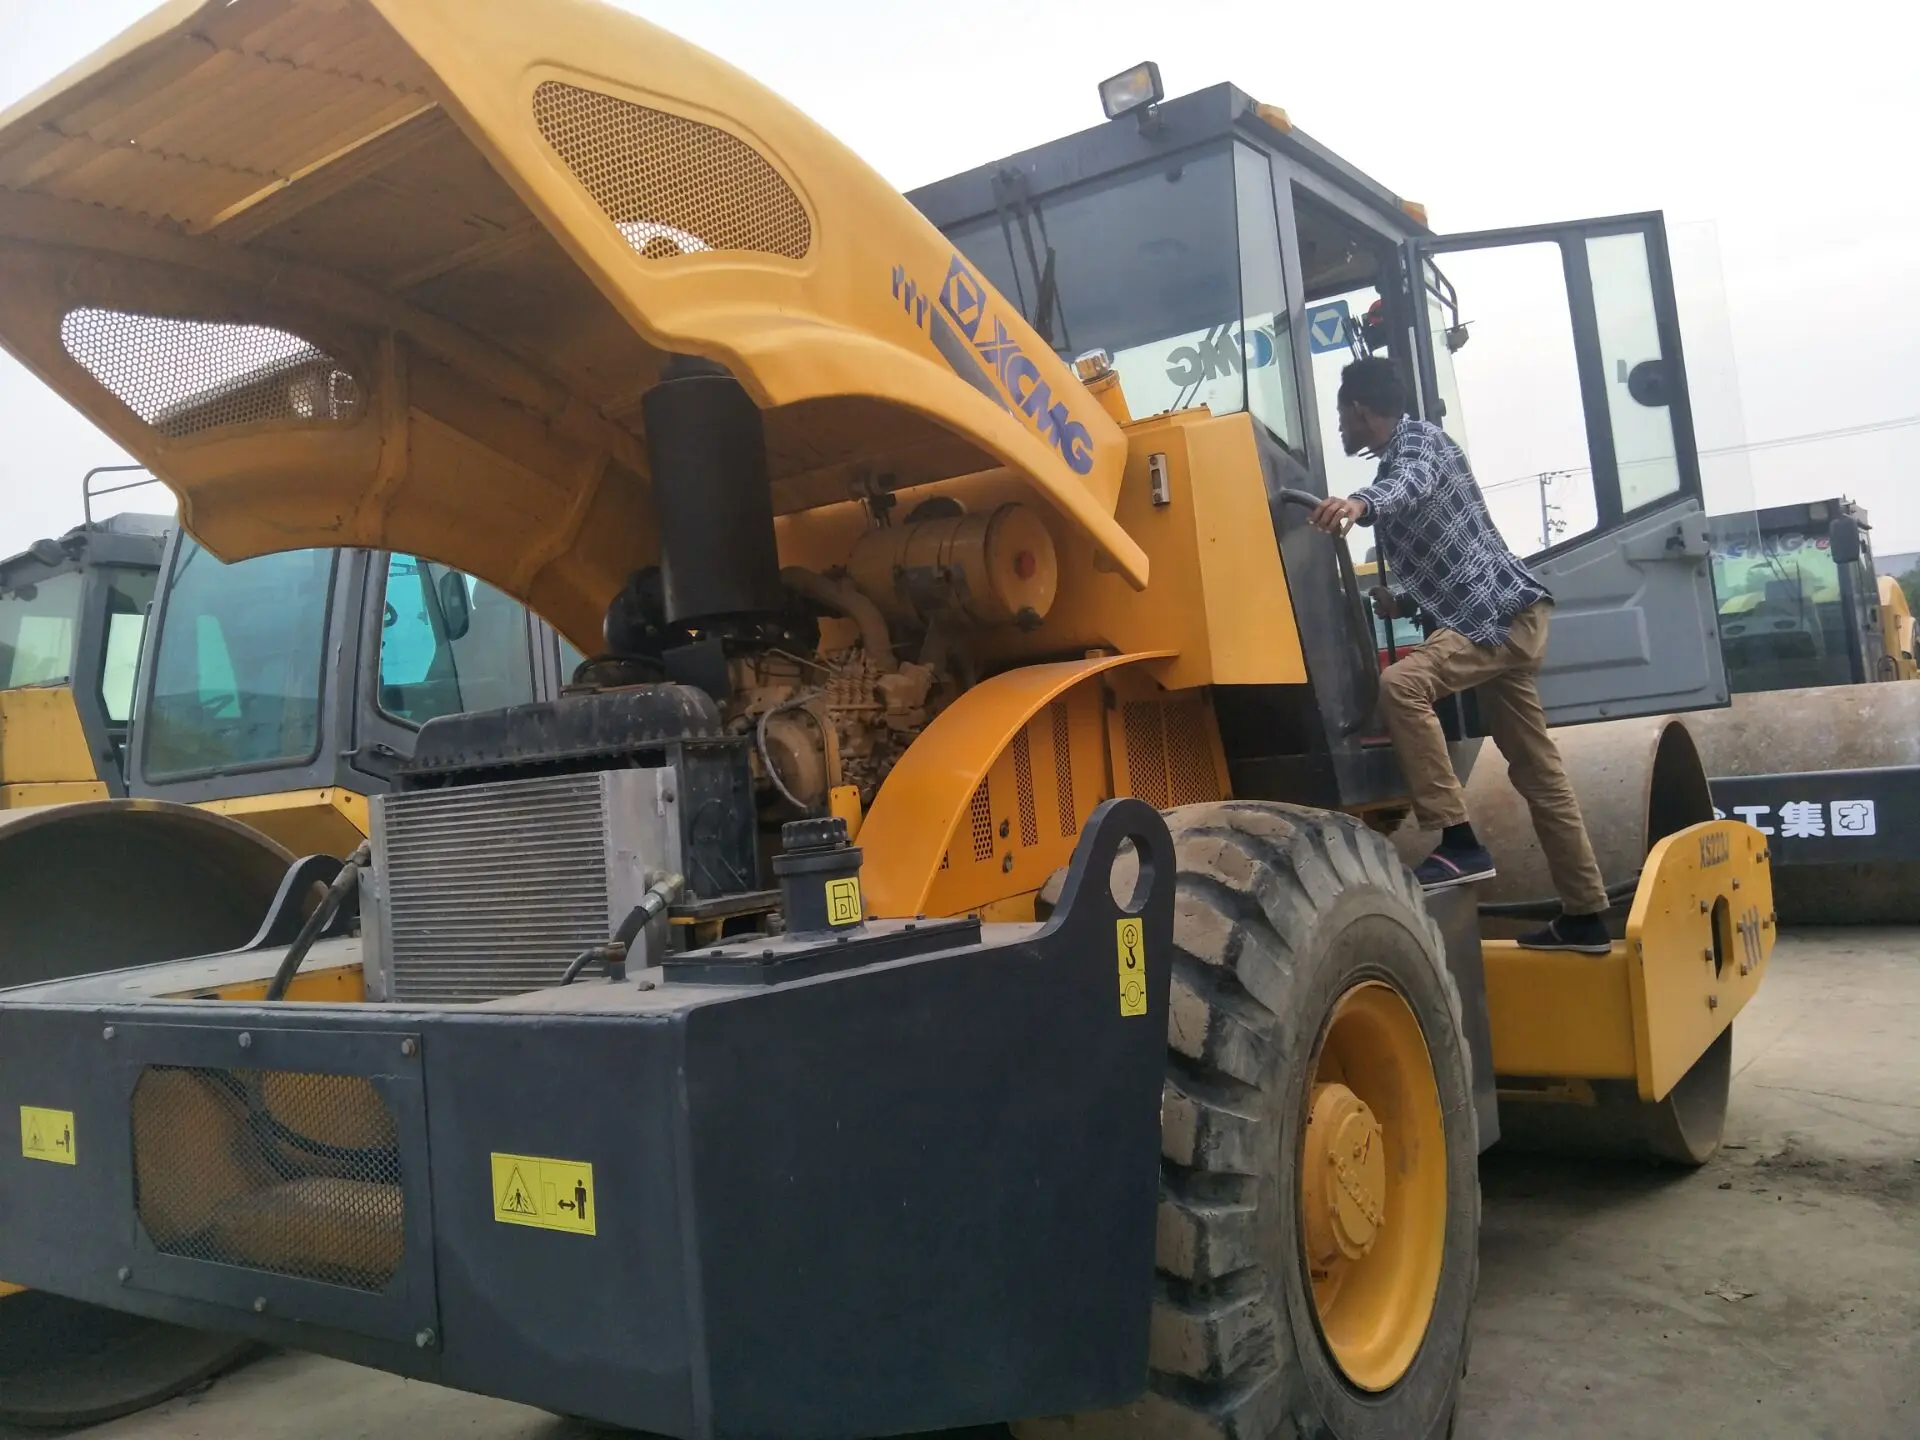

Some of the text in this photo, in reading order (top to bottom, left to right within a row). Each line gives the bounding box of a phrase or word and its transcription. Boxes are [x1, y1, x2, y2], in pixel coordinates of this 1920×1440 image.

[974, 314, 1094, 475] XCMG
[1713, 800, 1876, 838] 工集团
